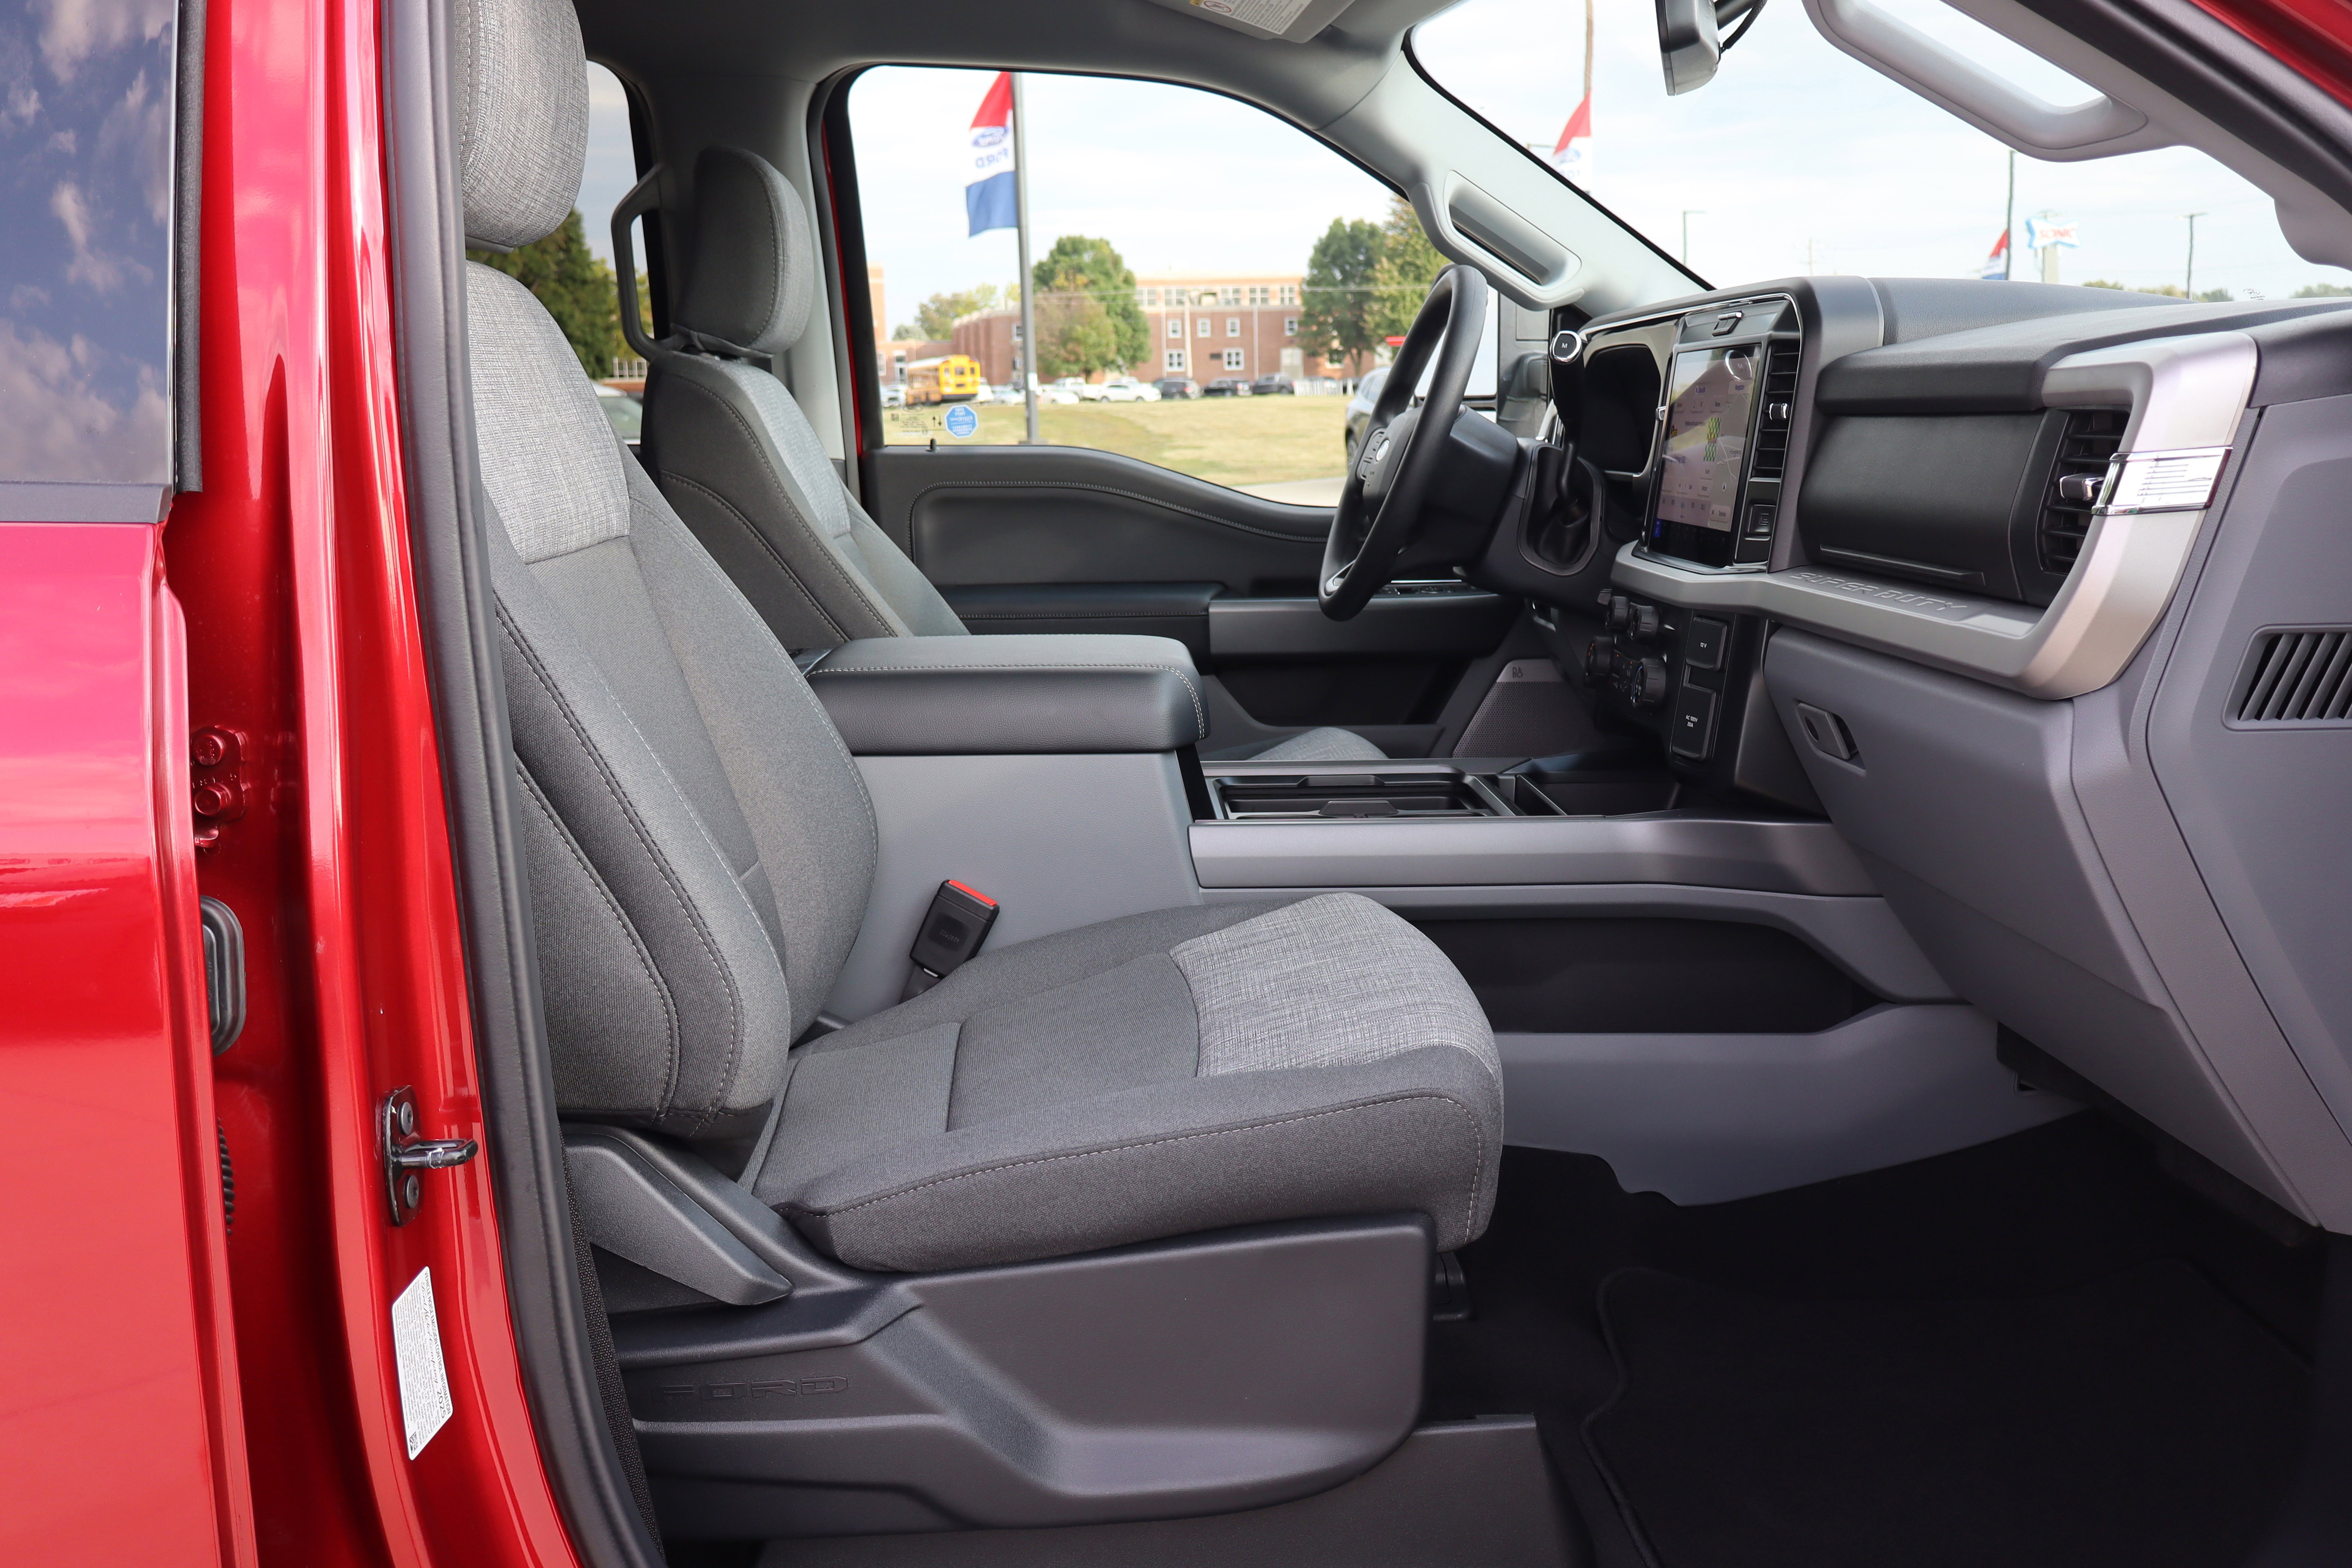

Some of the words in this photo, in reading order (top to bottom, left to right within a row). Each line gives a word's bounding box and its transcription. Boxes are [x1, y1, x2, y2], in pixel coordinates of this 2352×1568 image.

[2039, 228, 2076, 239] SONIC
[1789, 572, 1879, 594] SUPER
[1873, 590, 1967, 611] DUTY
[430, 1314, 439, 1345] EMISSION
[435, 1343, 443, 1374] CONTROL
[440, 1374, 451, 1414] INFORMATION
[653, 1376, 848, 1401] FORD
[437, 1389, 446, 1419] 2025
